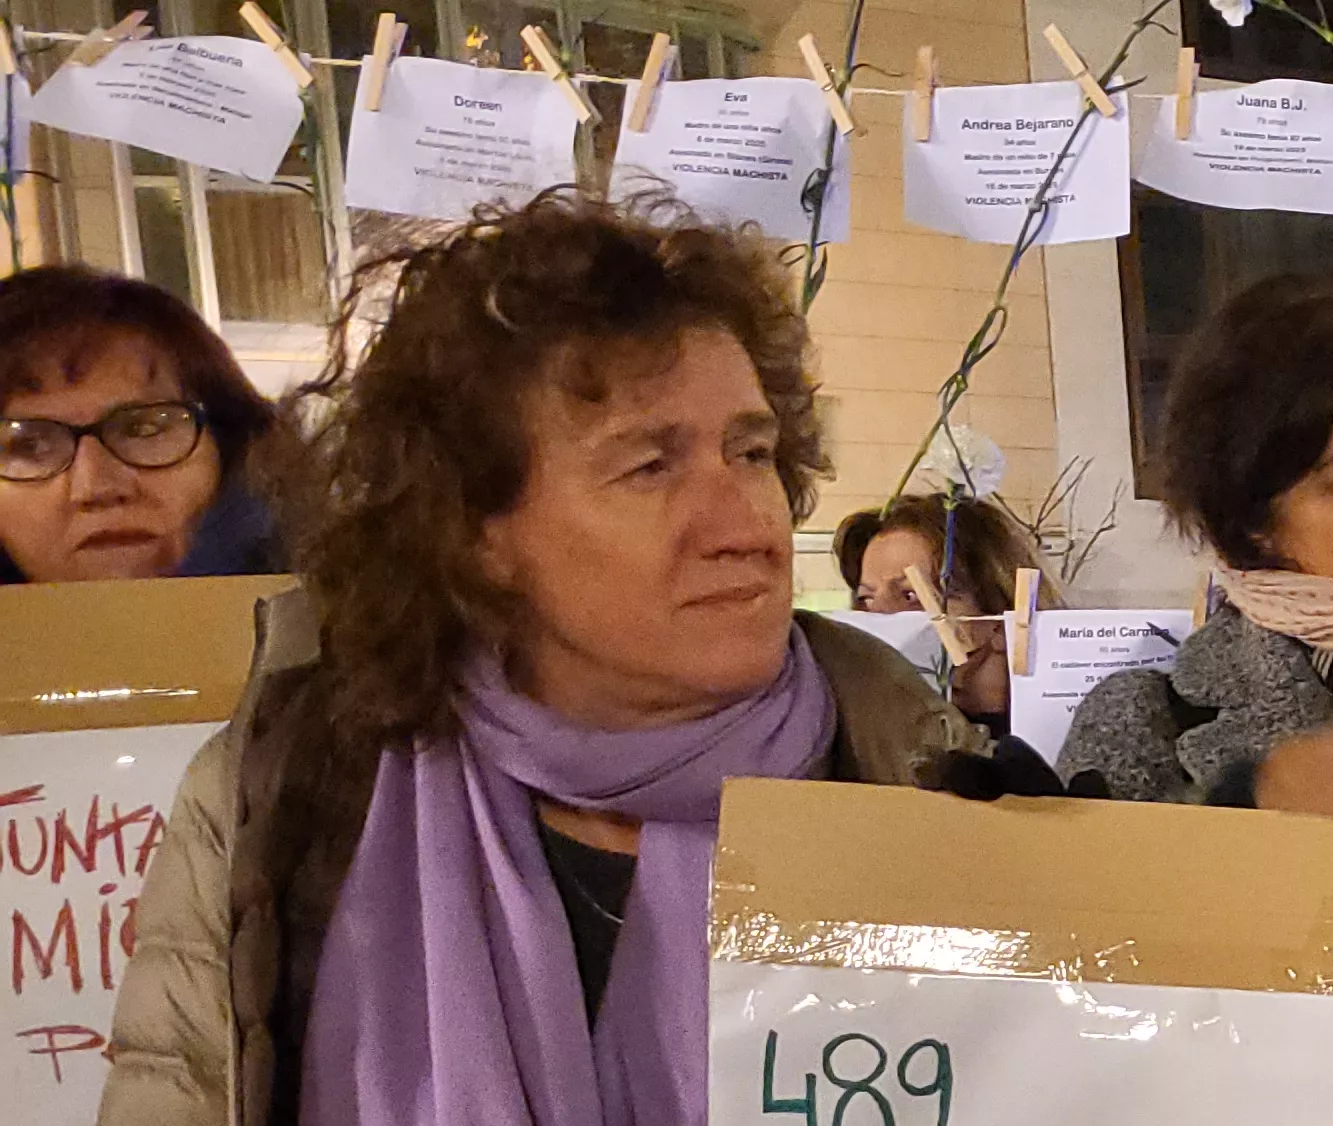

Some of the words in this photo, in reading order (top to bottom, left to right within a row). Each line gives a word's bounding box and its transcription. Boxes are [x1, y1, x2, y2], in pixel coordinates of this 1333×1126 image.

[454, 95, 502, 112] Doreen
[724, 92, 748, 102] Eva
[1236, 94, 1277, 109] Juana
[1280, 98, 1307, 111] B.J.
[961, 119, 1012, 131] Andrea
[1015, 118, 1074, 132] Bejarano
[672, 163, 730, 176] VIOLENCIA
[732, 167, 789, 180] MACHISTA
[965, 196, 1022, 205] VIOLENCIA
[1025, 194, 1076, 205] MHISTA
[1059, 627, 1094, 639] María
[1097, 626, 1116, 638] del
